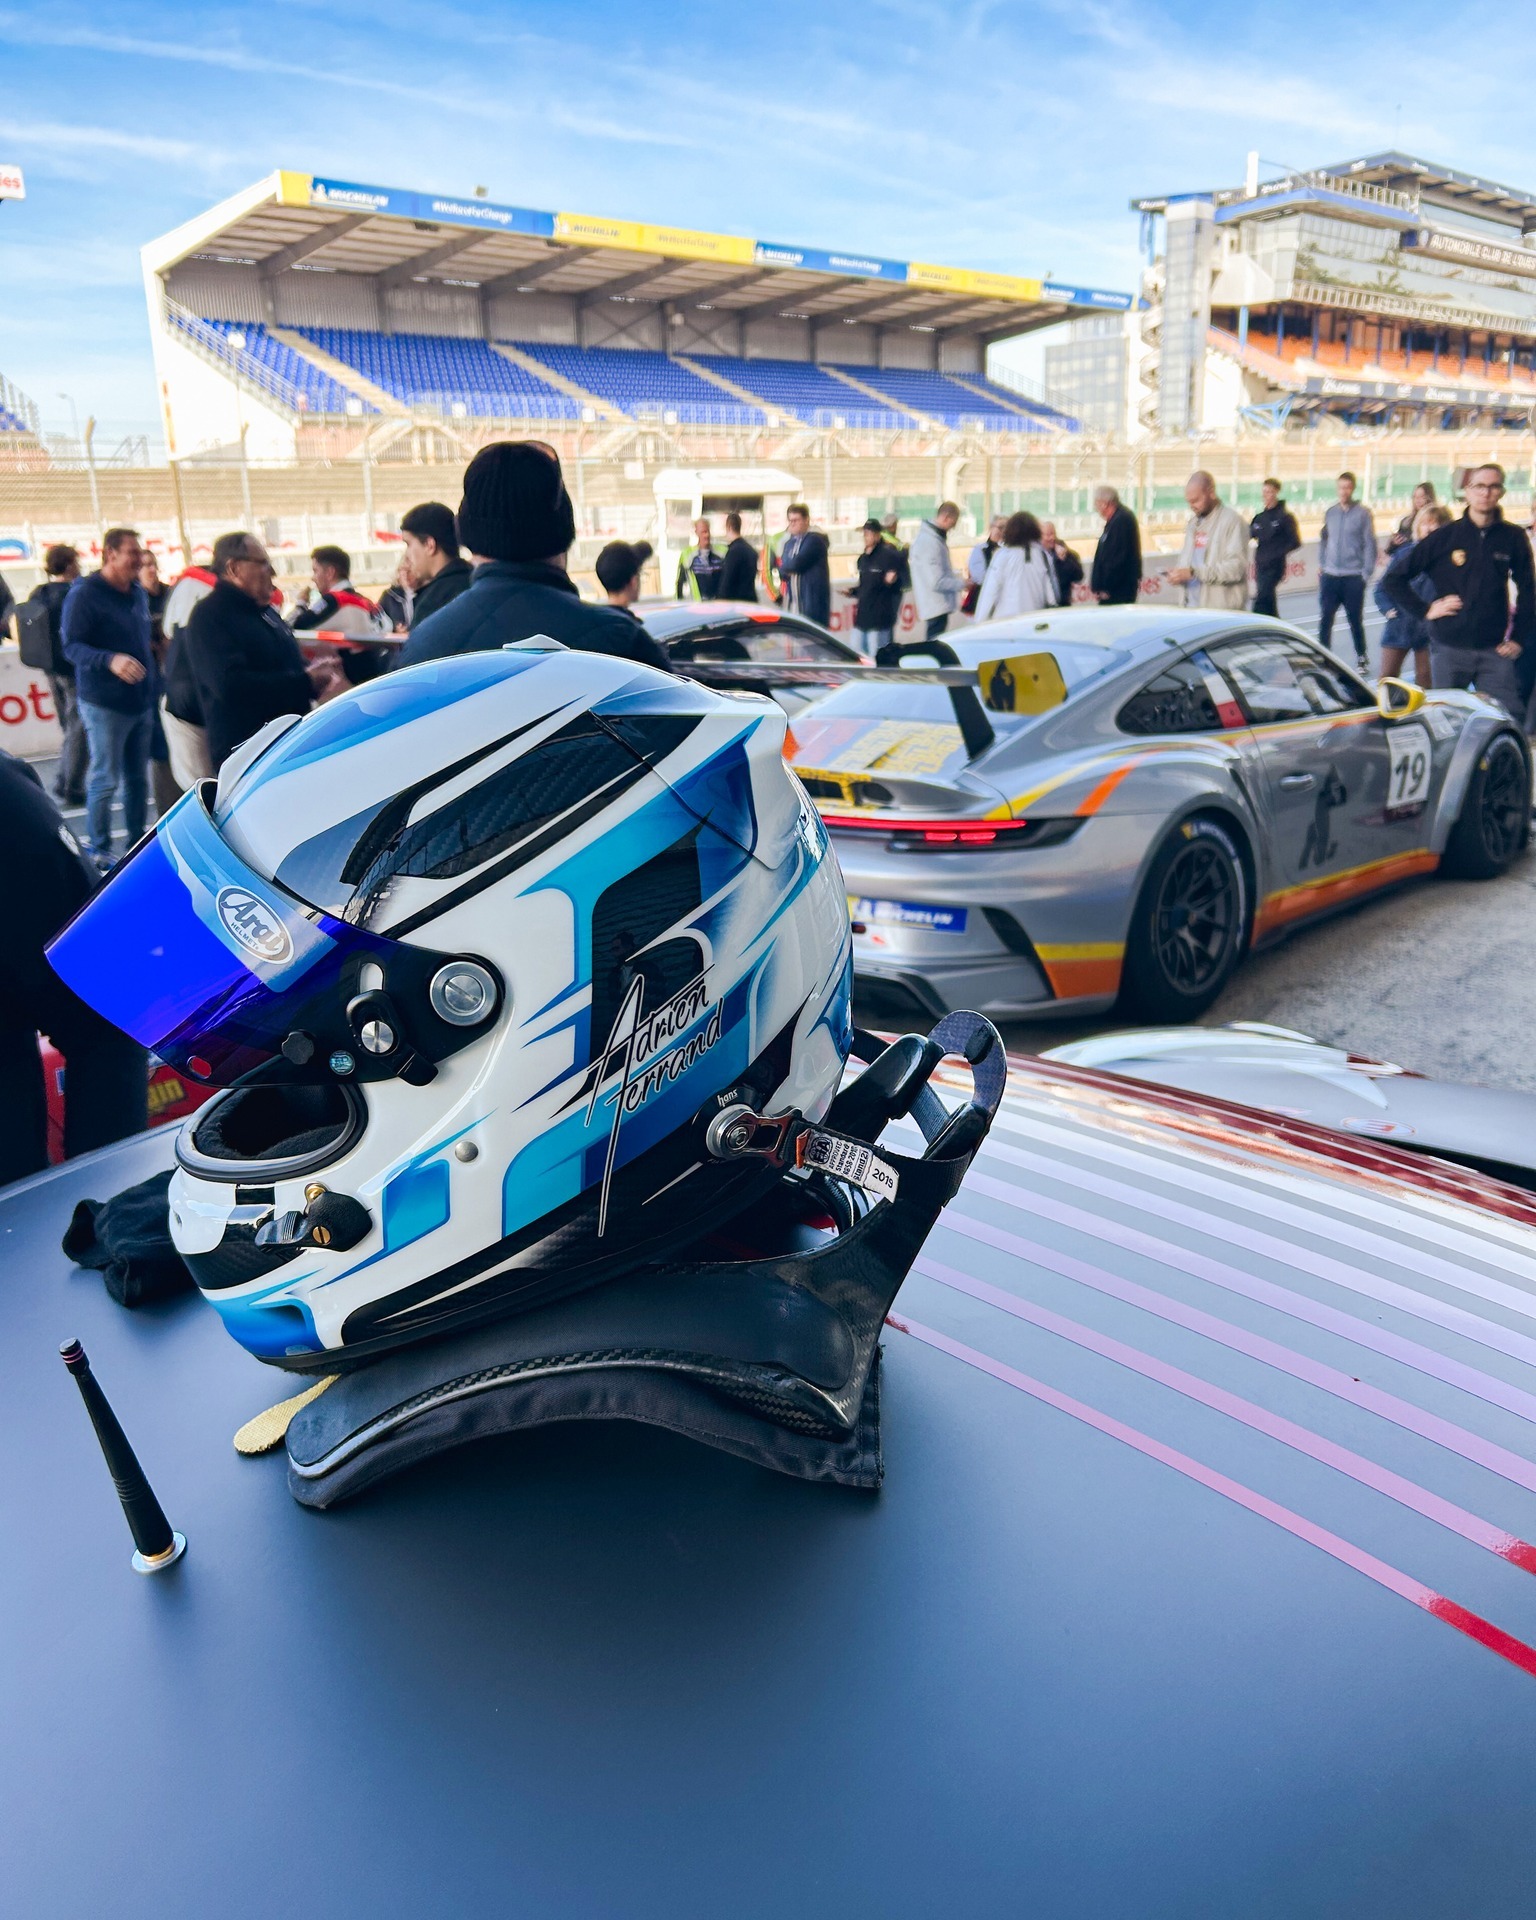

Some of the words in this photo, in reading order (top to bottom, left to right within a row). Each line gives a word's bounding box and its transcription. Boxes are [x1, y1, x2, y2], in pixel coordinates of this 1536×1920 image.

[1429, 234, 1480, 258] AUTOMOBILE
[1512, 253, 1536, 271] L'OUES
[1395, 752, 1427, 801] 19
[220, 900, 287, 952] Arai
[230, 922, 259, 949] HELMET
[584, 963, 715, 1127] Adrien
[716, 1088, 738, 1108] hans
[835, 1143, 851, 1172] Standard
[872, 1168, 894, 1188] 2019
